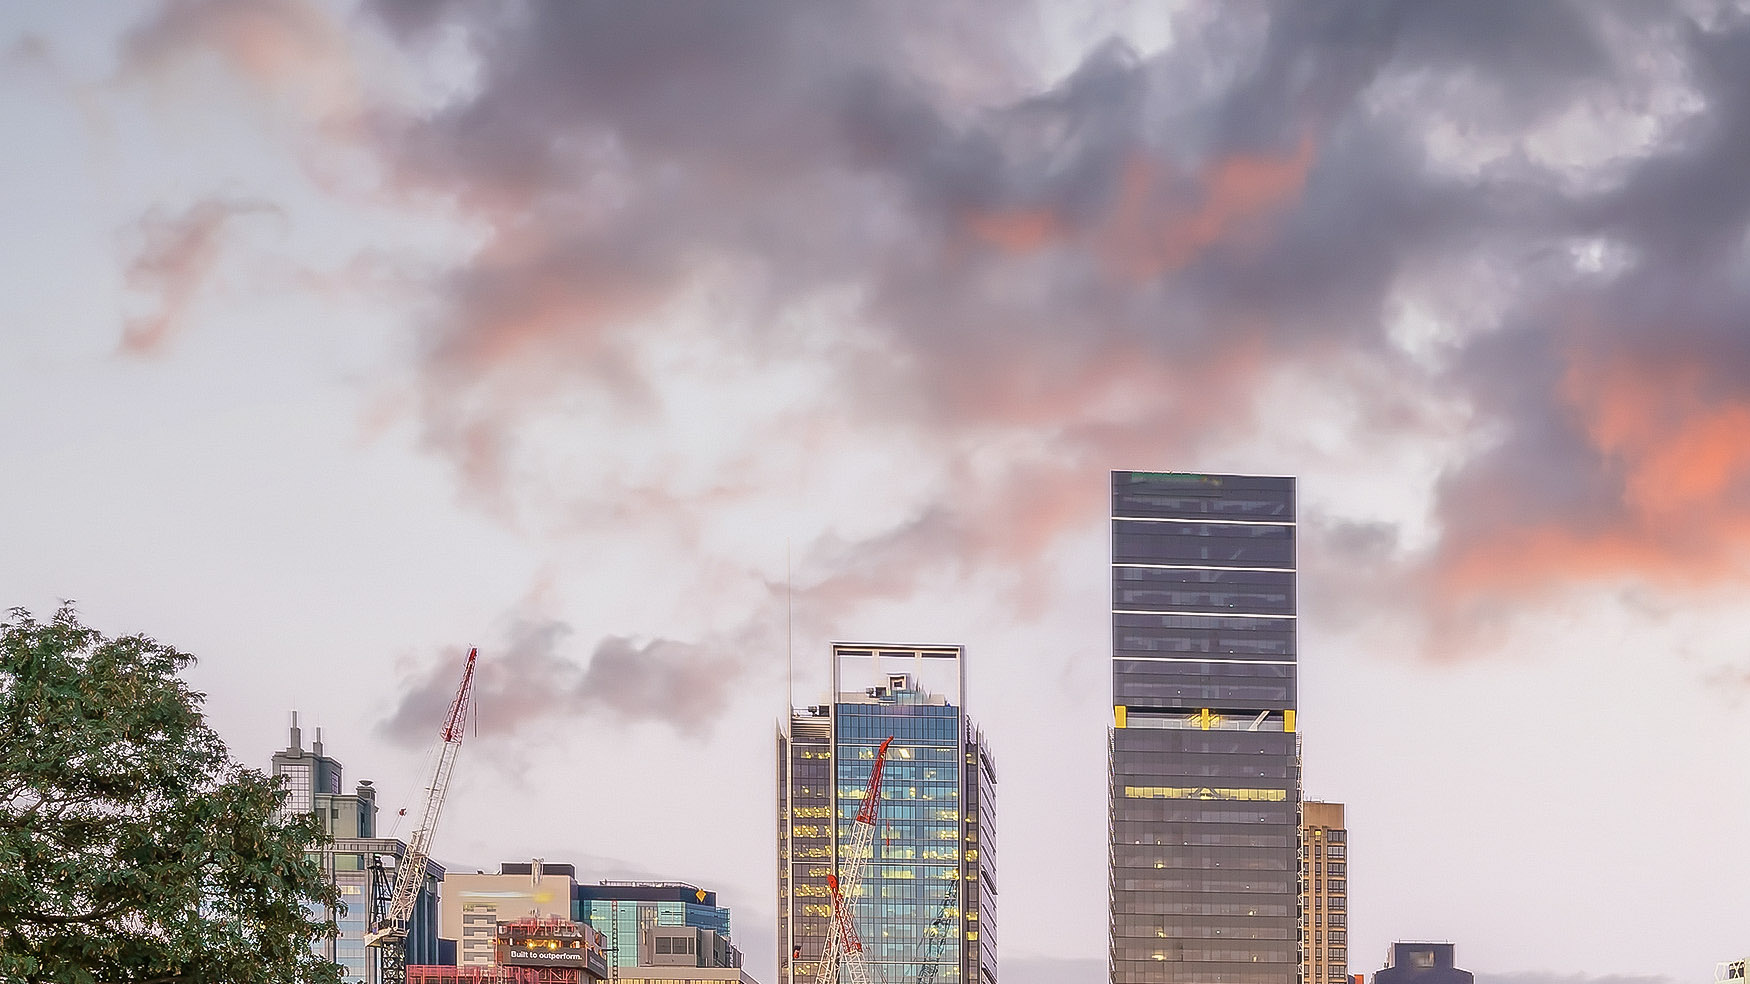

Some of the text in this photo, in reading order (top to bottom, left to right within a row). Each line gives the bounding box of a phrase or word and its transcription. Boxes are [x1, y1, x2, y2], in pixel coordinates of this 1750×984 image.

[511, 950, 583, 960] Built to outperform.
